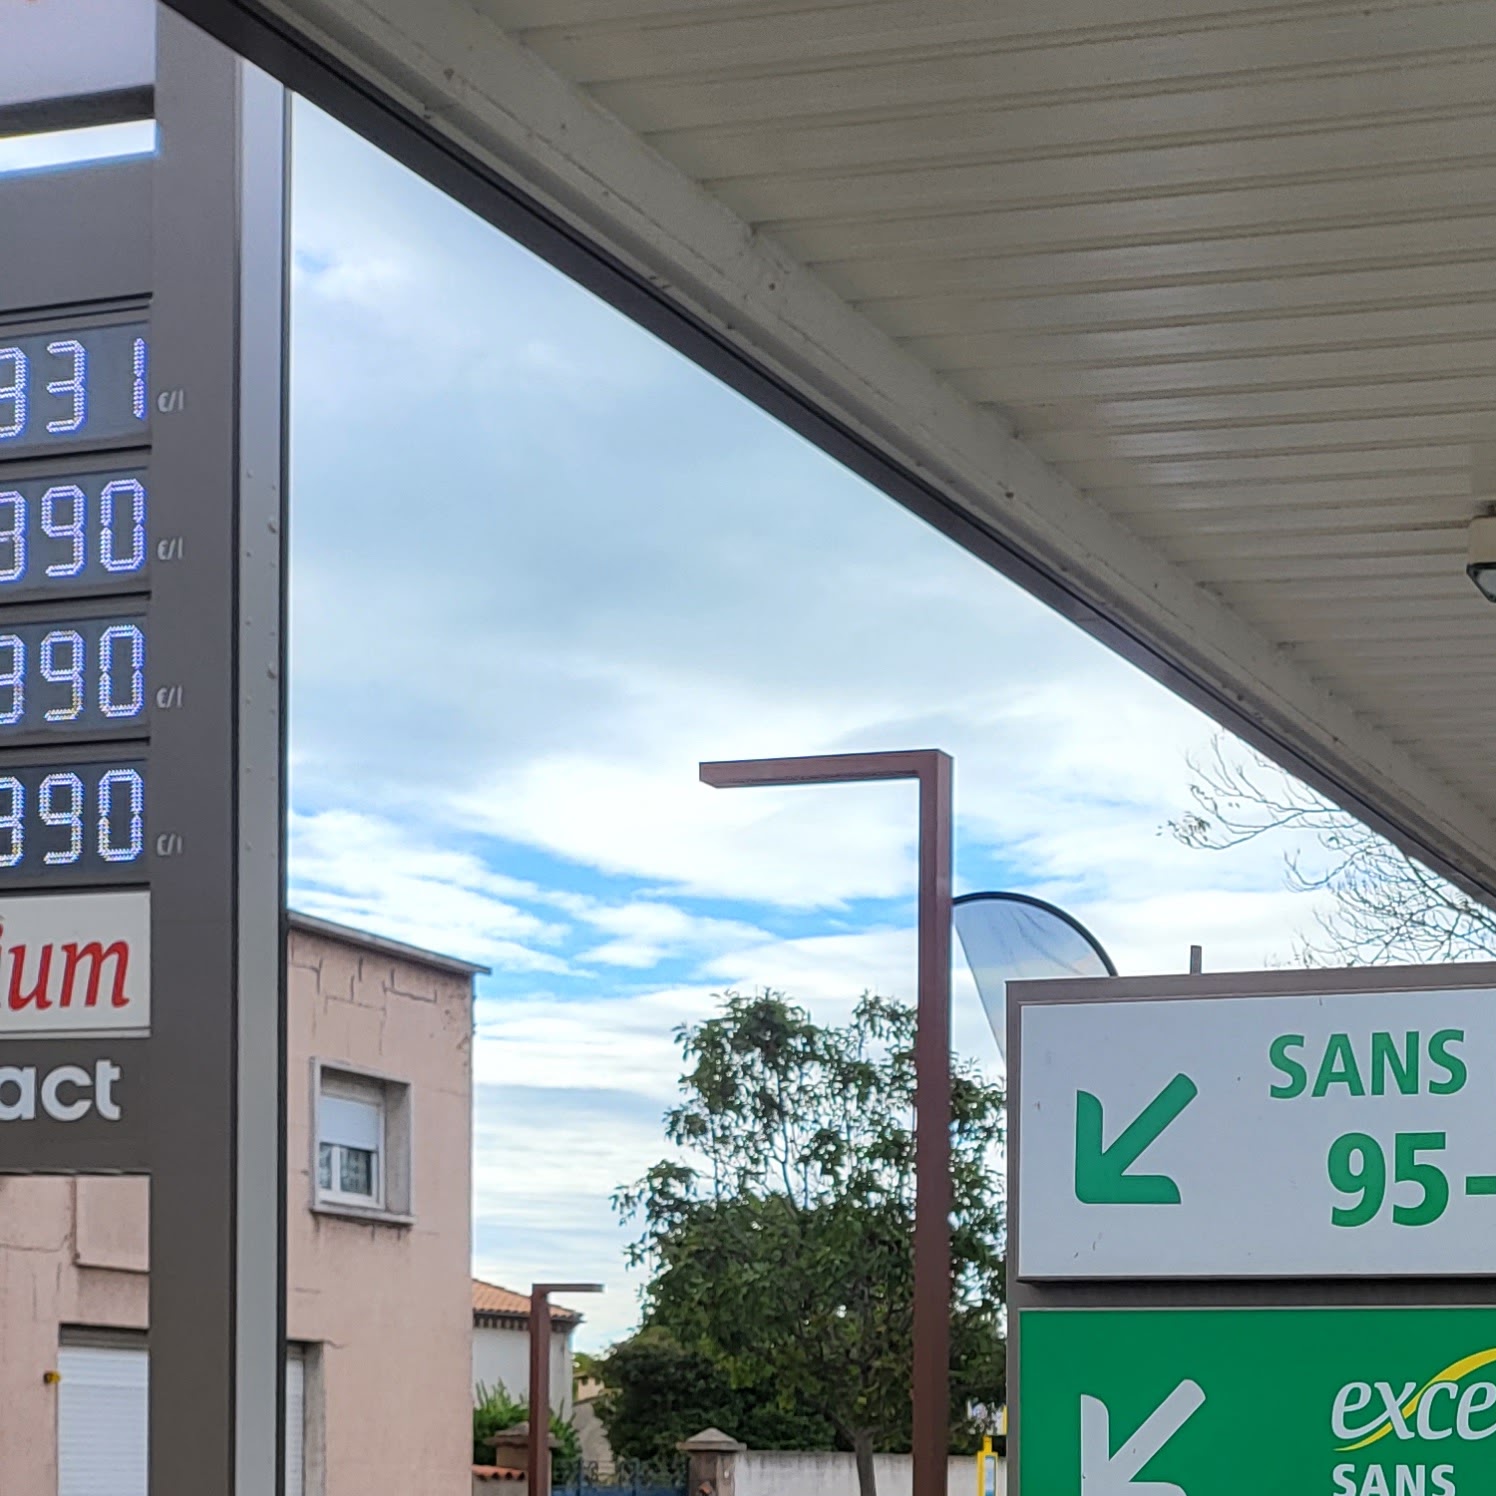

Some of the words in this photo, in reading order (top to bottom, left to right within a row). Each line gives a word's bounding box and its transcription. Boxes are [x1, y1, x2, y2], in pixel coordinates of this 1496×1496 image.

[0, 922, 130, 1012] um
[0, 1059, 122, 1122] act
[1267, 1027, 1469, 1101] SANS
